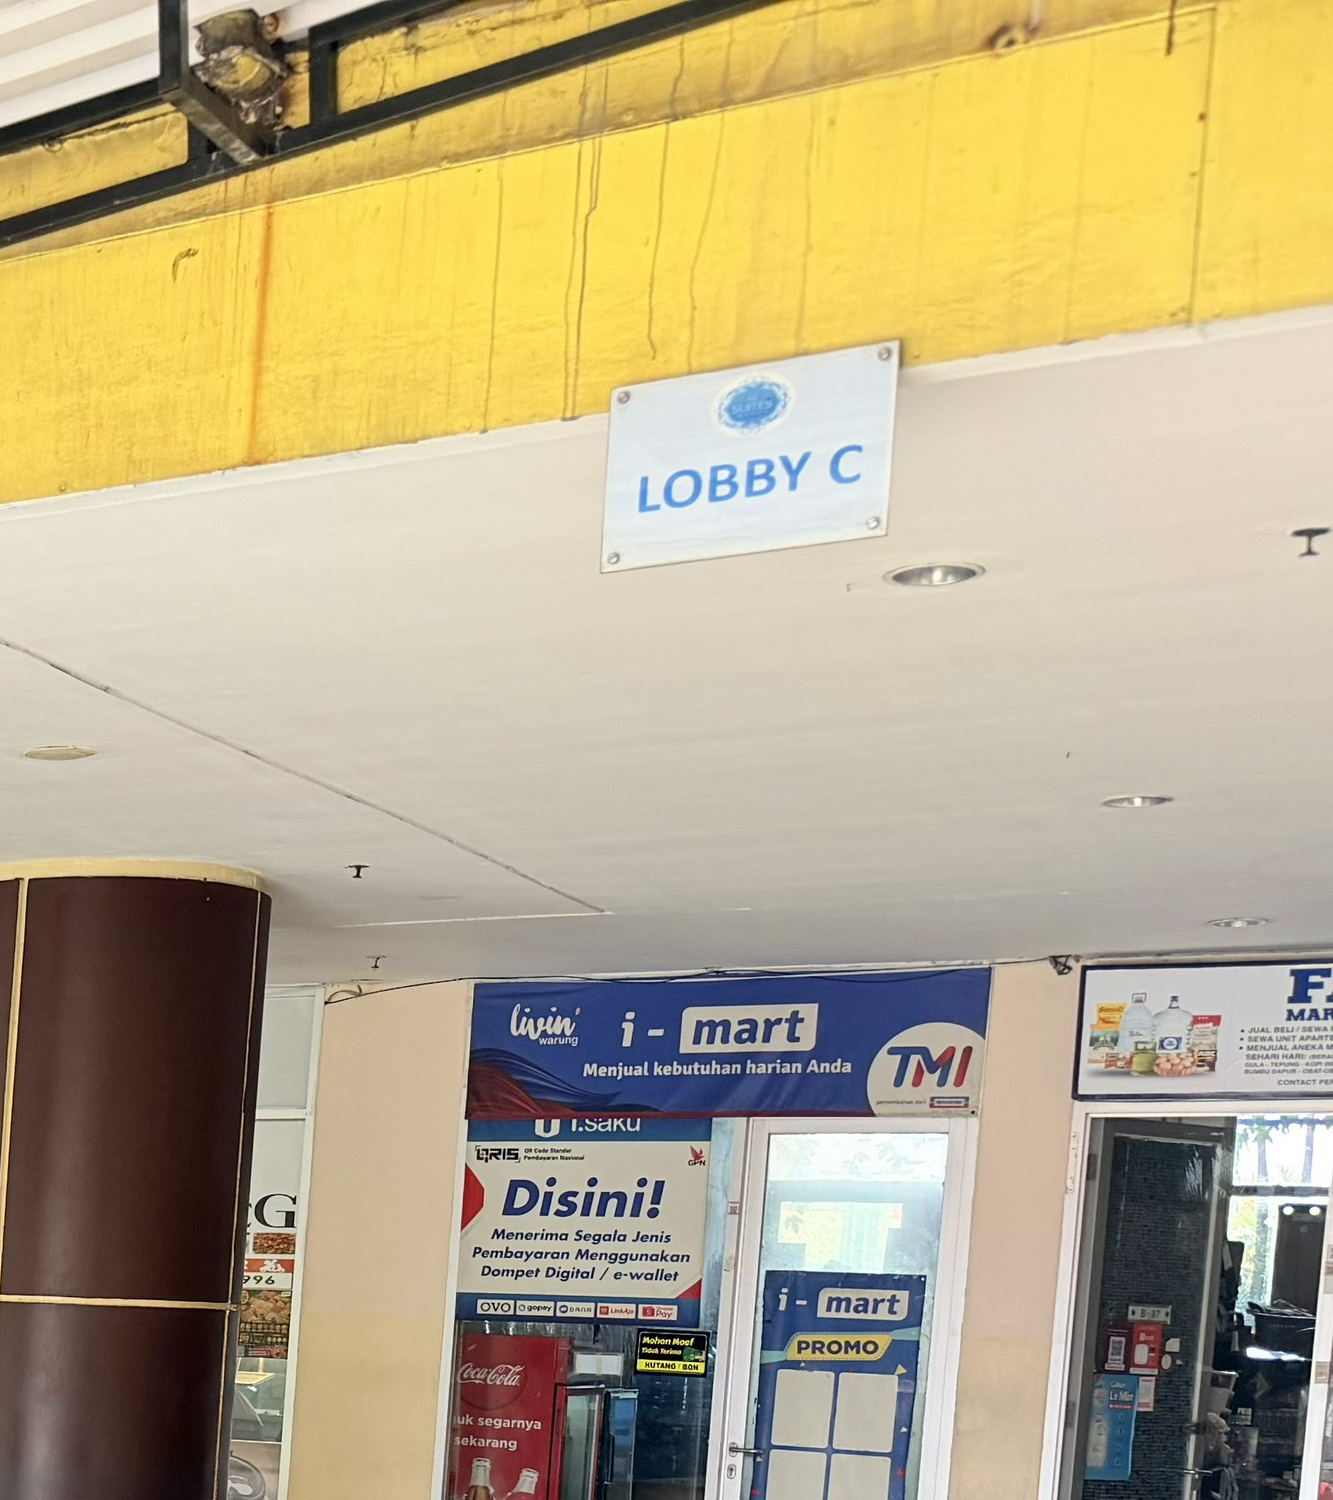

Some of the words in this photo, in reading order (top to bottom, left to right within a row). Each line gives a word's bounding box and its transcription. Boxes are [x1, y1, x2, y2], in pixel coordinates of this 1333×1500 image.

[637, 451, 812, 514] LOBBY
[829, 444, 863, 485] C
[1287, 968, 1333, 1004] F
[621, 1011, 636, 1047] i
[691, 1009, 805, 1046] mart
[538, 1035, 579, 1047] warung
[583, 1063, 649, 1080] Menjual
[653, 1062, 742, 1077] kebutuhan
[745, 1059, 803, 1075] harian
[806, 1058, 852, 1074] Anda
[887, 1045, 973, 1088] TMI
[476, 1147, 521, 1163] QRIS
[501, 1176, 665, 1219] Disini!
[491, 1228, 569, 1243] Menerima
[573, 1229, 627, 1245] Segala
[631, 1231, 672, 1244] Jenis
[472, 1246, 570, 1263] Pembayaran
[574, 1249, 691, 1265] Menggunakan
[480, 1265, 541, 1280] Dompet
[544, 1266, 596, 1282] Digital
[613, 1267, 679, 1283] e-wallet
[480, 1302, 511, 1313] OVO
[526, 1305, 552, 1313] gopay
[778, 1287, 789, 1311] i
[825, 1294, 901, 1315] mart
[655, 1311, 674, 1319] Pay
[642, 1336, 671, 1345] Mohon
[796, 1340, 880, 1355] PROMO
[457, 1362, 525, 1387] Coca-Cola
[478, 1415, 541, 1430] segarnya
[454, 1437, 517, 1451] sekarang
